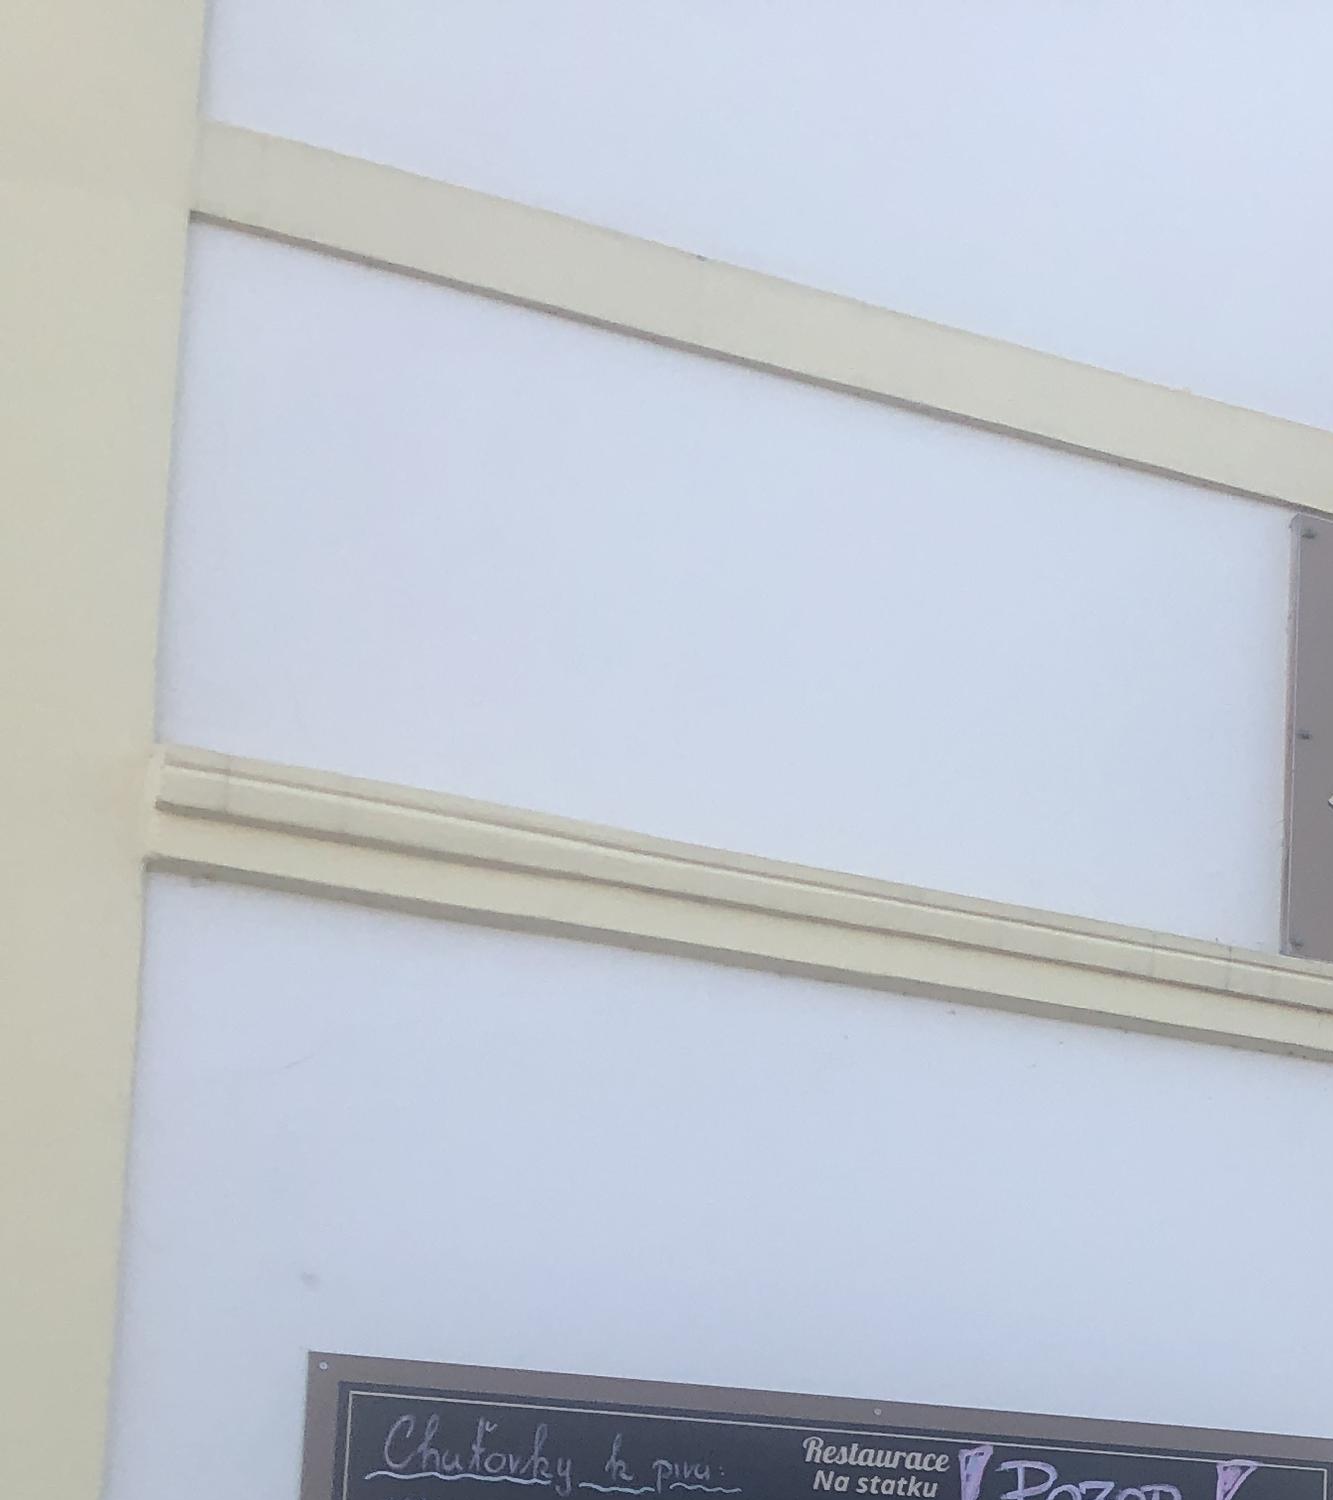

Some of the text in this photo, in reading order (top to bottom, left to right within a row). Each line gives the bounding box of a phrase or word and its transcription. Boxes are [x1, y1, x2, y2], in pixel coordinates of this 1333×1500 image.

[607, 1433, 636, 1481] k
[803, 1435, 951, 1472] Restaurace
[812, 1470, 939, 1499] Na statku
